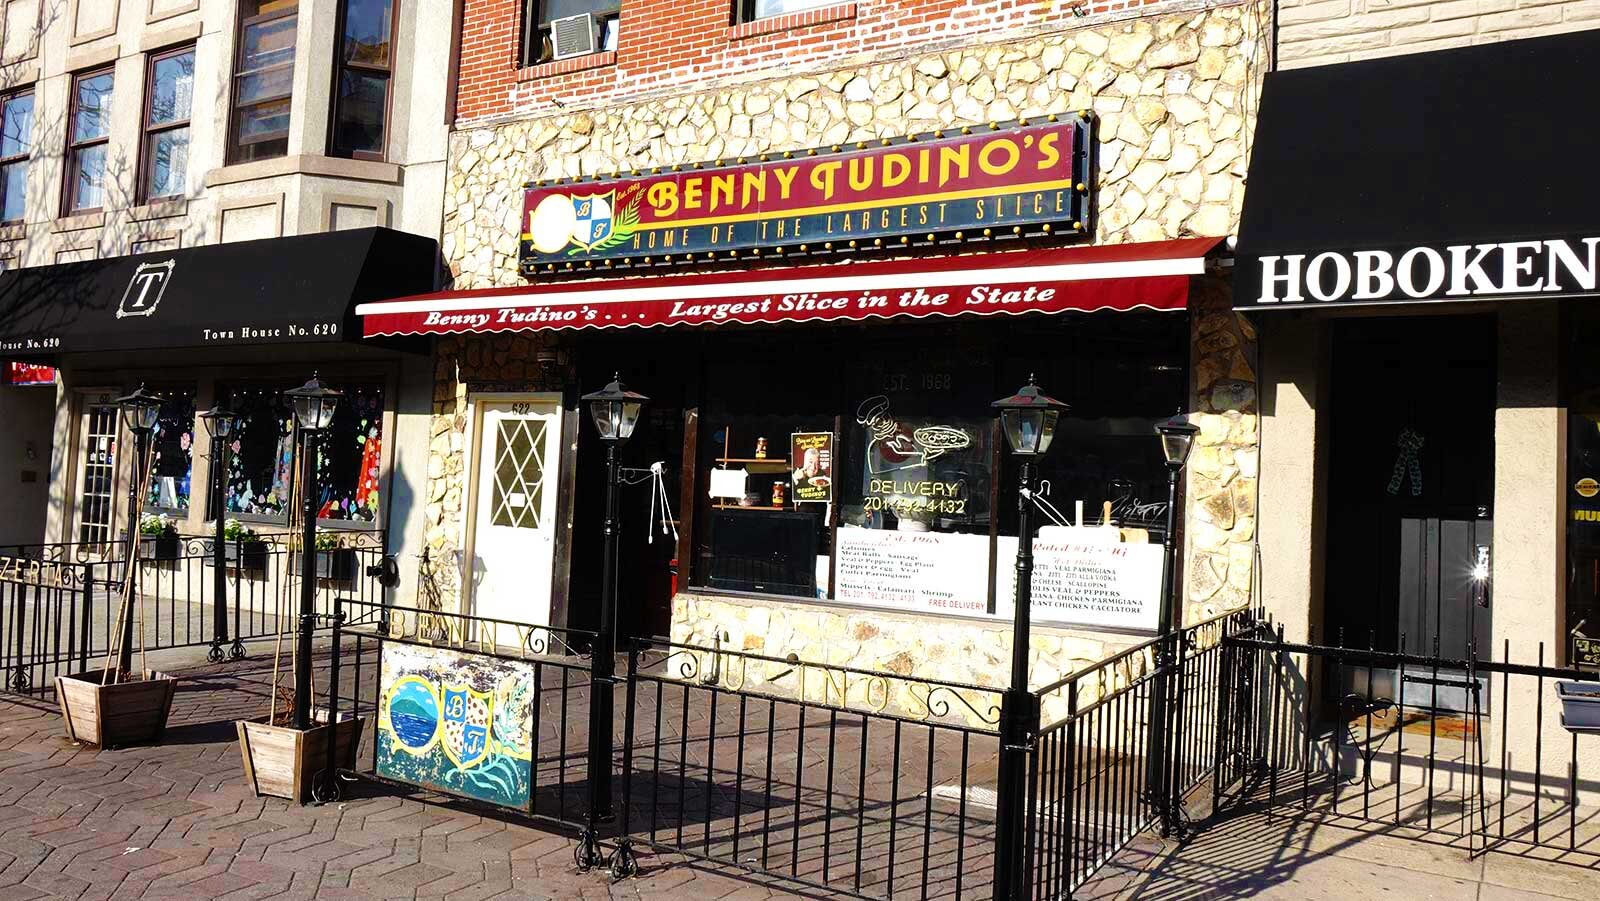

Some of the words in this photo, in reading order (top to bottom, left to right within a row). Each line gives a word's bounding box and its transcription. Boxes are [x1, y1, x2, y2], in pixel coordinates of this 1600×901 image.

[647, 166, 798, 217] BENNY
[809, 132, 1061, 200] TUDINO'S
[577, 201, 592, 217] B
[633, 227, 689, 250] HOME
[711, 226, 734, 244] OF
[761, 218, 801, 239] THE
[827, 203, 948, 234] LARGEST
[976, 191, 1064, 220] SLICE
[1257, 237, 1600, 303] HOBOKEN
[131, 271, 165, 307] T
[424, 311, 490, 328] Benny
[496, 305, 598, 324] Tudino's
[669, 297, 771, 319] Largest
[778, 294, 849, 312] Slice
[858, 291, 888, 308] in
[899, 289, 950, 307] the
[965, 286, 1056, 305] State
[203, 328, 234, 340] Town
[242, 327, 280, 338] House
[289, 324, 309, 336] No.
[313, 323, 337, 335] 620
[0, 341, 22, 350] ouse
[43, 337, 60, 348] 620
[512, 402, 530, 415] 622
[870, 479, 958, 496] DELIVERY
[1057, 593, 1090, 602] CHICKEN
[1092, 596, 1143, 606] PARMIGIANA
[1084, 589, 1120, 597] PEPPERS
[928, 598, 946, 608] FREE
[949, 600, 985, 610] DELIVERY
[1055, 601, 1089, 610] CHICKEN
[1091, 604, 1141, 613] CACCIATORE
[389, 608, 534, 660] BENNY
[447, 695, 464, 717] B
